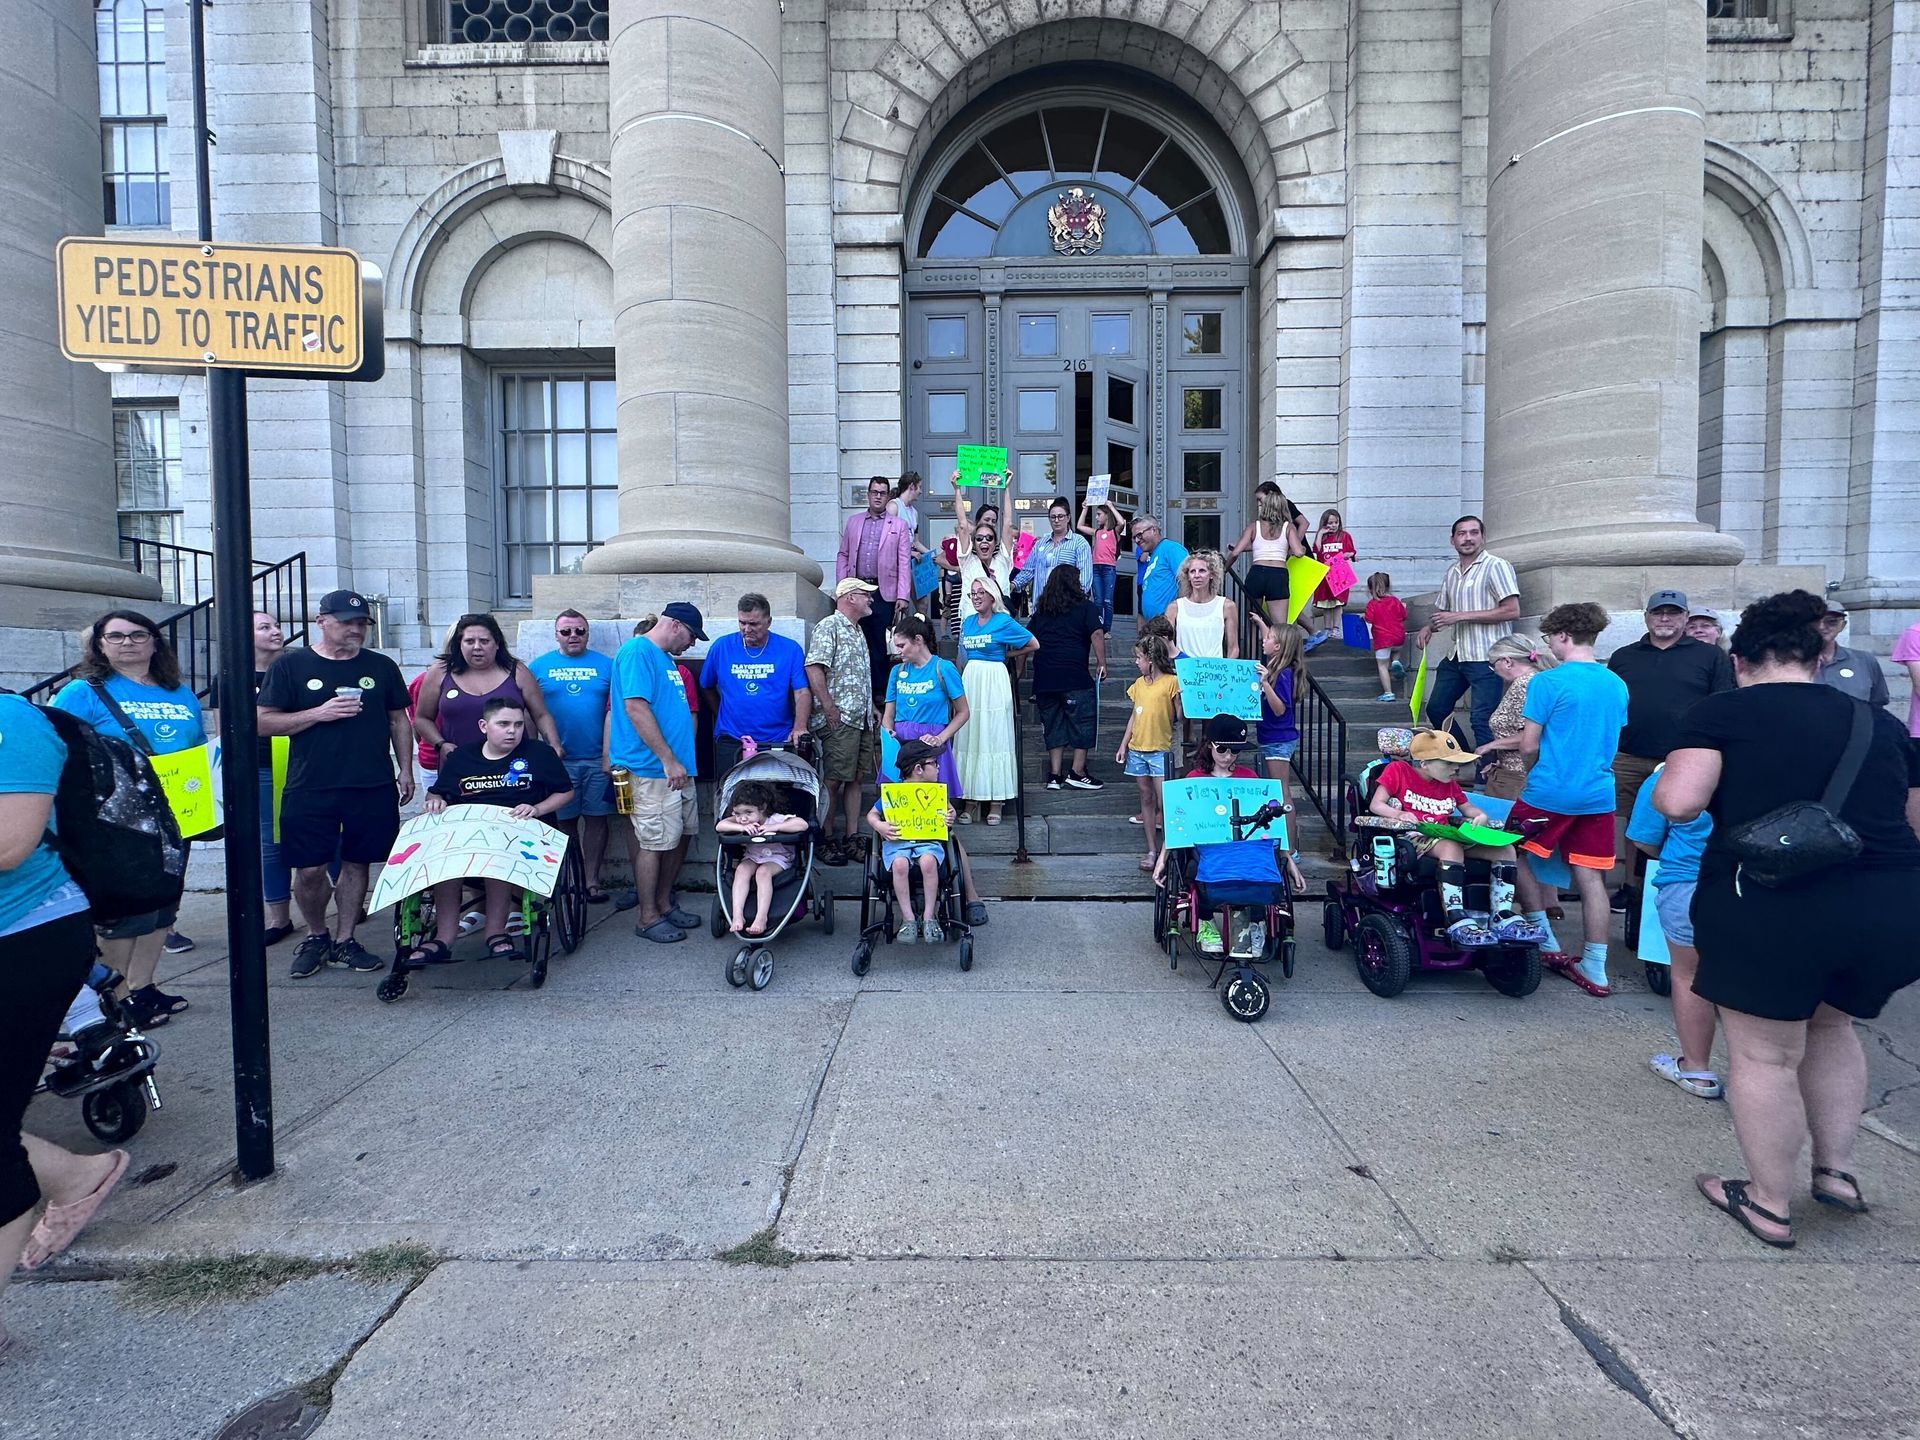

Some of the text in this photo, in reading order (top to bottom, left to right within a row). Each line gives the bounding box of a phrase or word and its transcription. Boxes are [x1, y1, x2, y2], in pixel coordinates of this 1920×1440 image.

[94, 256, 324, 304] PEDESTRIANS
[76, 304, 345, 354] YIELD TO TRAFFIC
[1063, 359, 1087, 371] 216
[465, 780, 519, 790] QUIKSILVER
[886, 791, 909, 808] We
[409, 805, 567, 848] INCLUSIVE
[421, 829, 519, 860] PLAY
[374, 853, 555, 911] MATTERS
